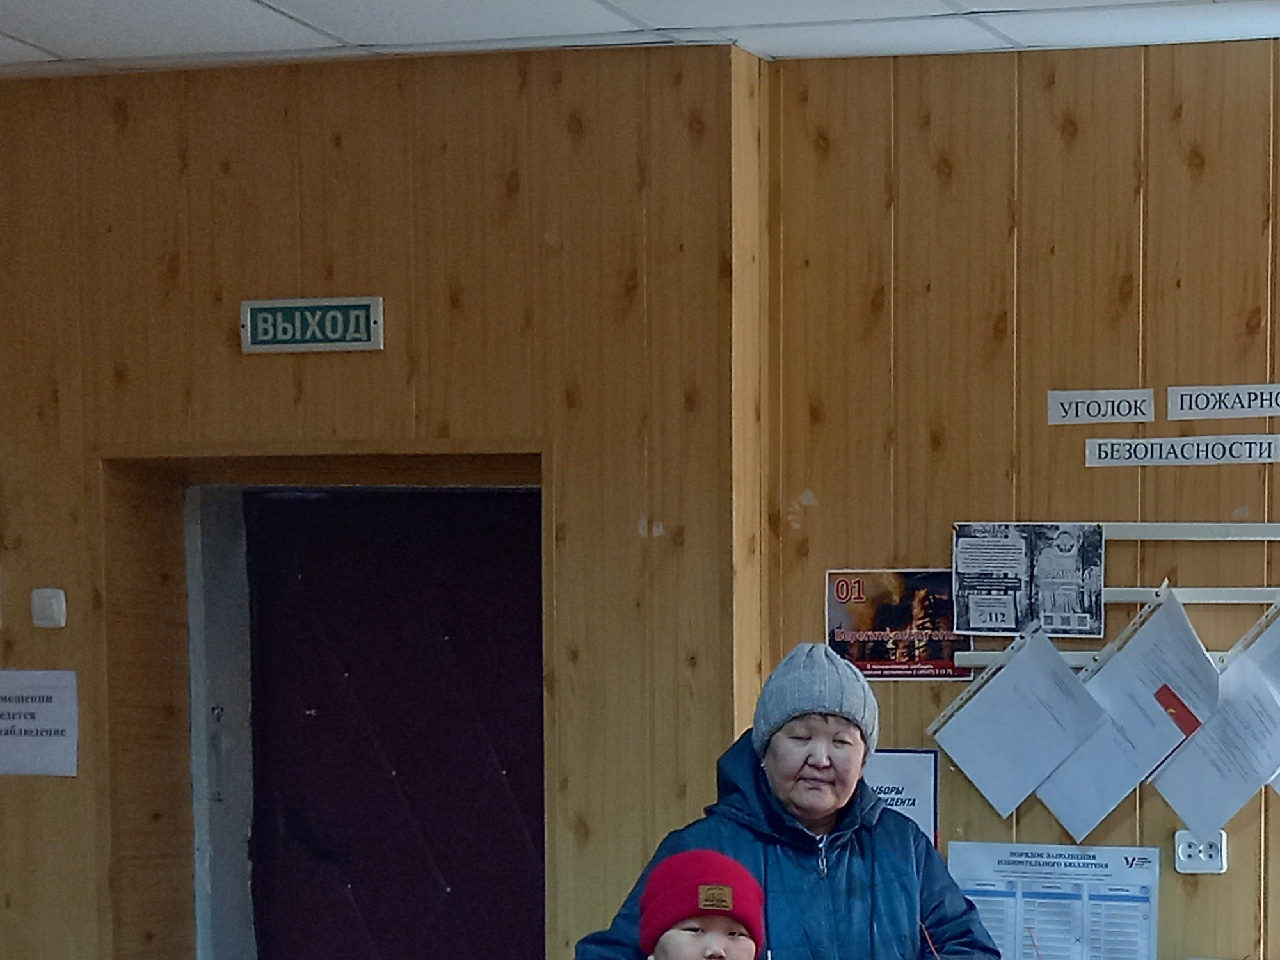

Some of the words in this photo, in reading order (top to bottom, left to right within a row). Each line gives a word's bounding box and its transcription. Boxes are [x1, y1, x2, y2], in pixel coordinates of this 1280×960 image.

[256, 309, 368, 341] ВЫХОД
[1059, 398, 1147, 419] УГОЛОК
[1096, 441, 1273, 461] БЕЗОПАСНОСТИ
[835, 578, 866, 603] 01
[988, 611, 1006, 623] 112
[871, 785, 905, 795] ЫБОРЫ
